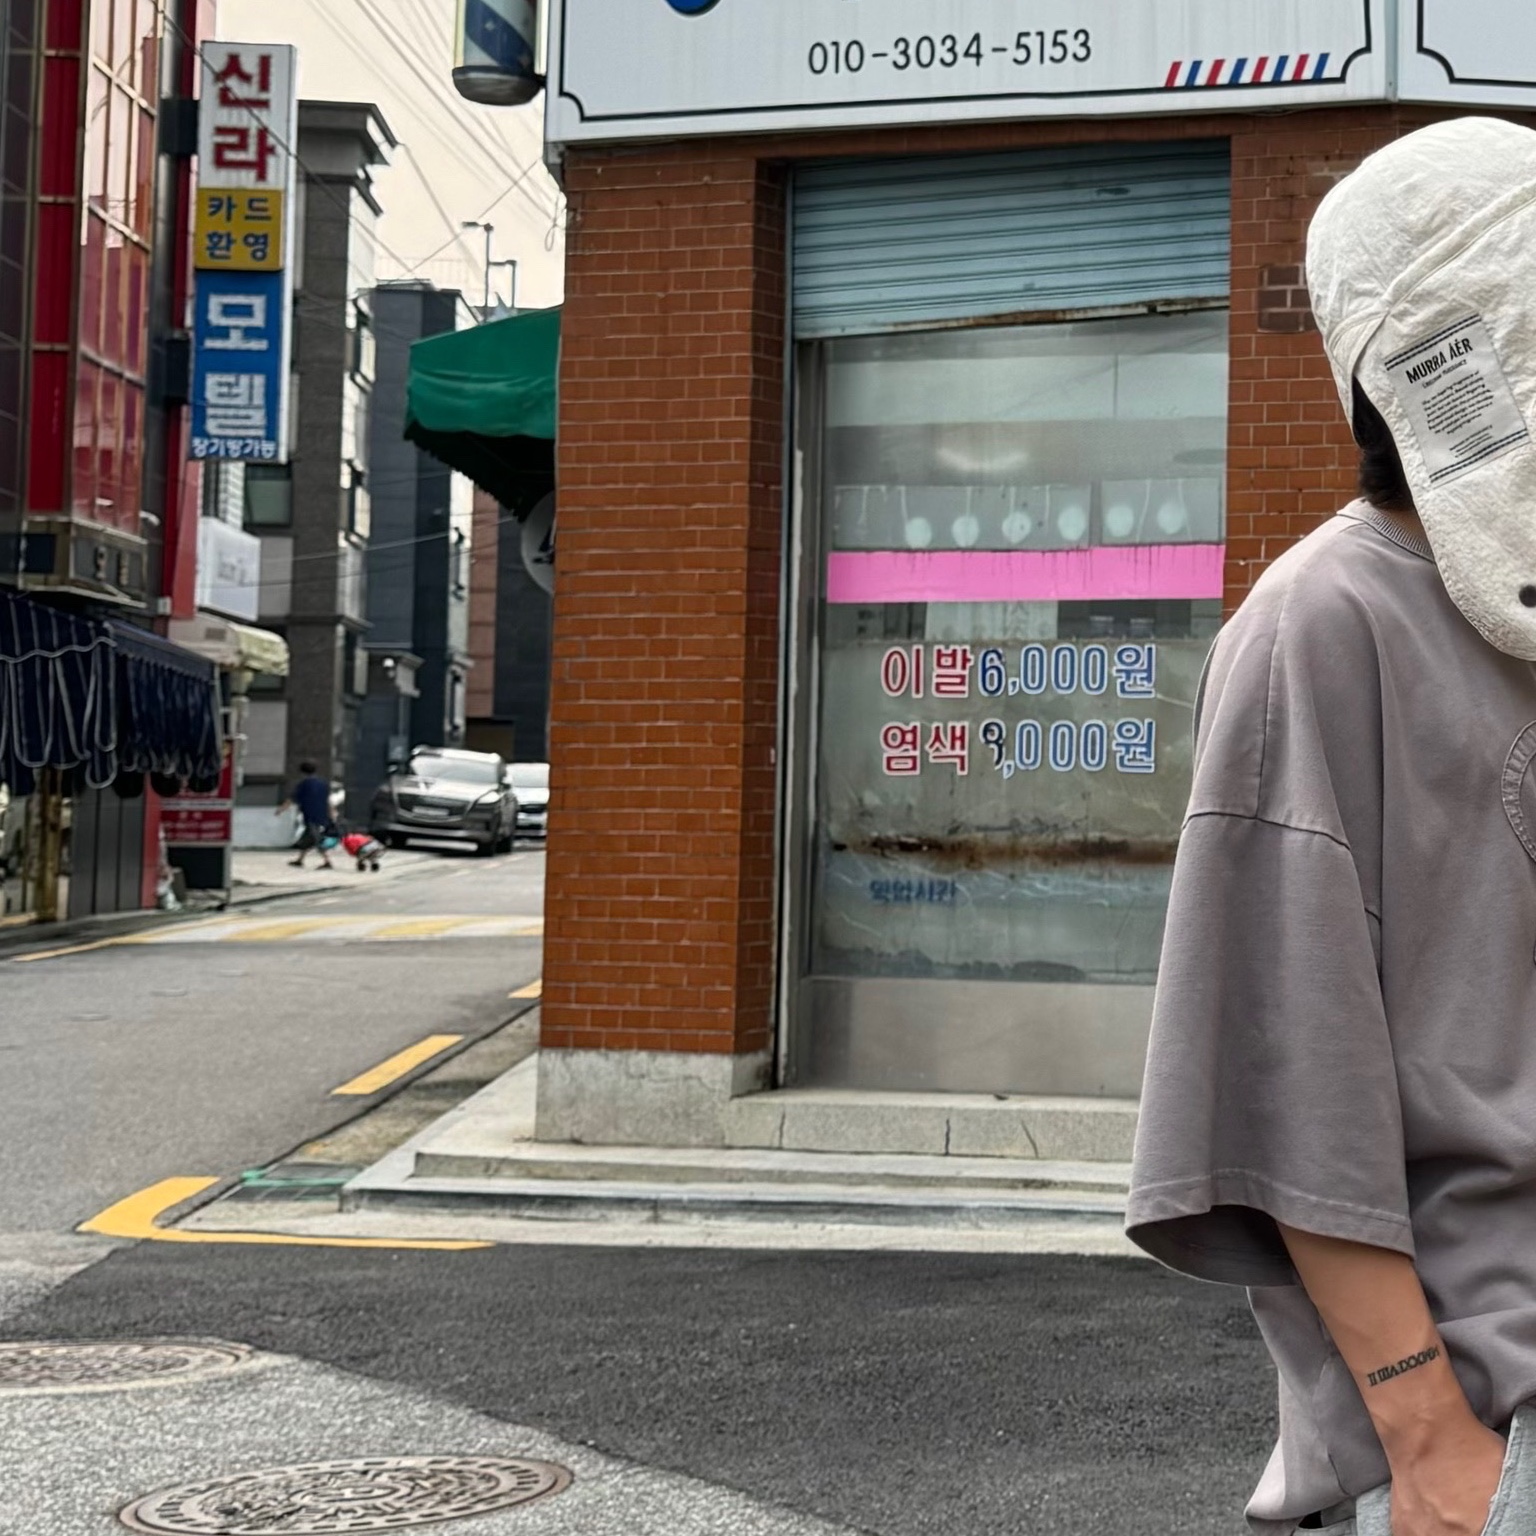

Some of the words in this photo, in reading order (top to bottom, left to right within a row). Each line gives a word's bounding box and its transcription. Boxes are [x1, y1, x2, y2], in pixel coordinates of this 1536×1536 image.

[808, 28, 1092, 75] 010-3034-5153
[213, 53, 277, 183] 신라
[207, 195, 272, 223] 카드
[206, 231, 269, 262] 환영
[203, 293, 269, 439] 모텔
[1405, 350, 1448, 385] MURRA
[881, 643, 974, 700] 이발
[977, 642, 1157, 700] 6,000원
[880, 720, 970, 777] 염색
